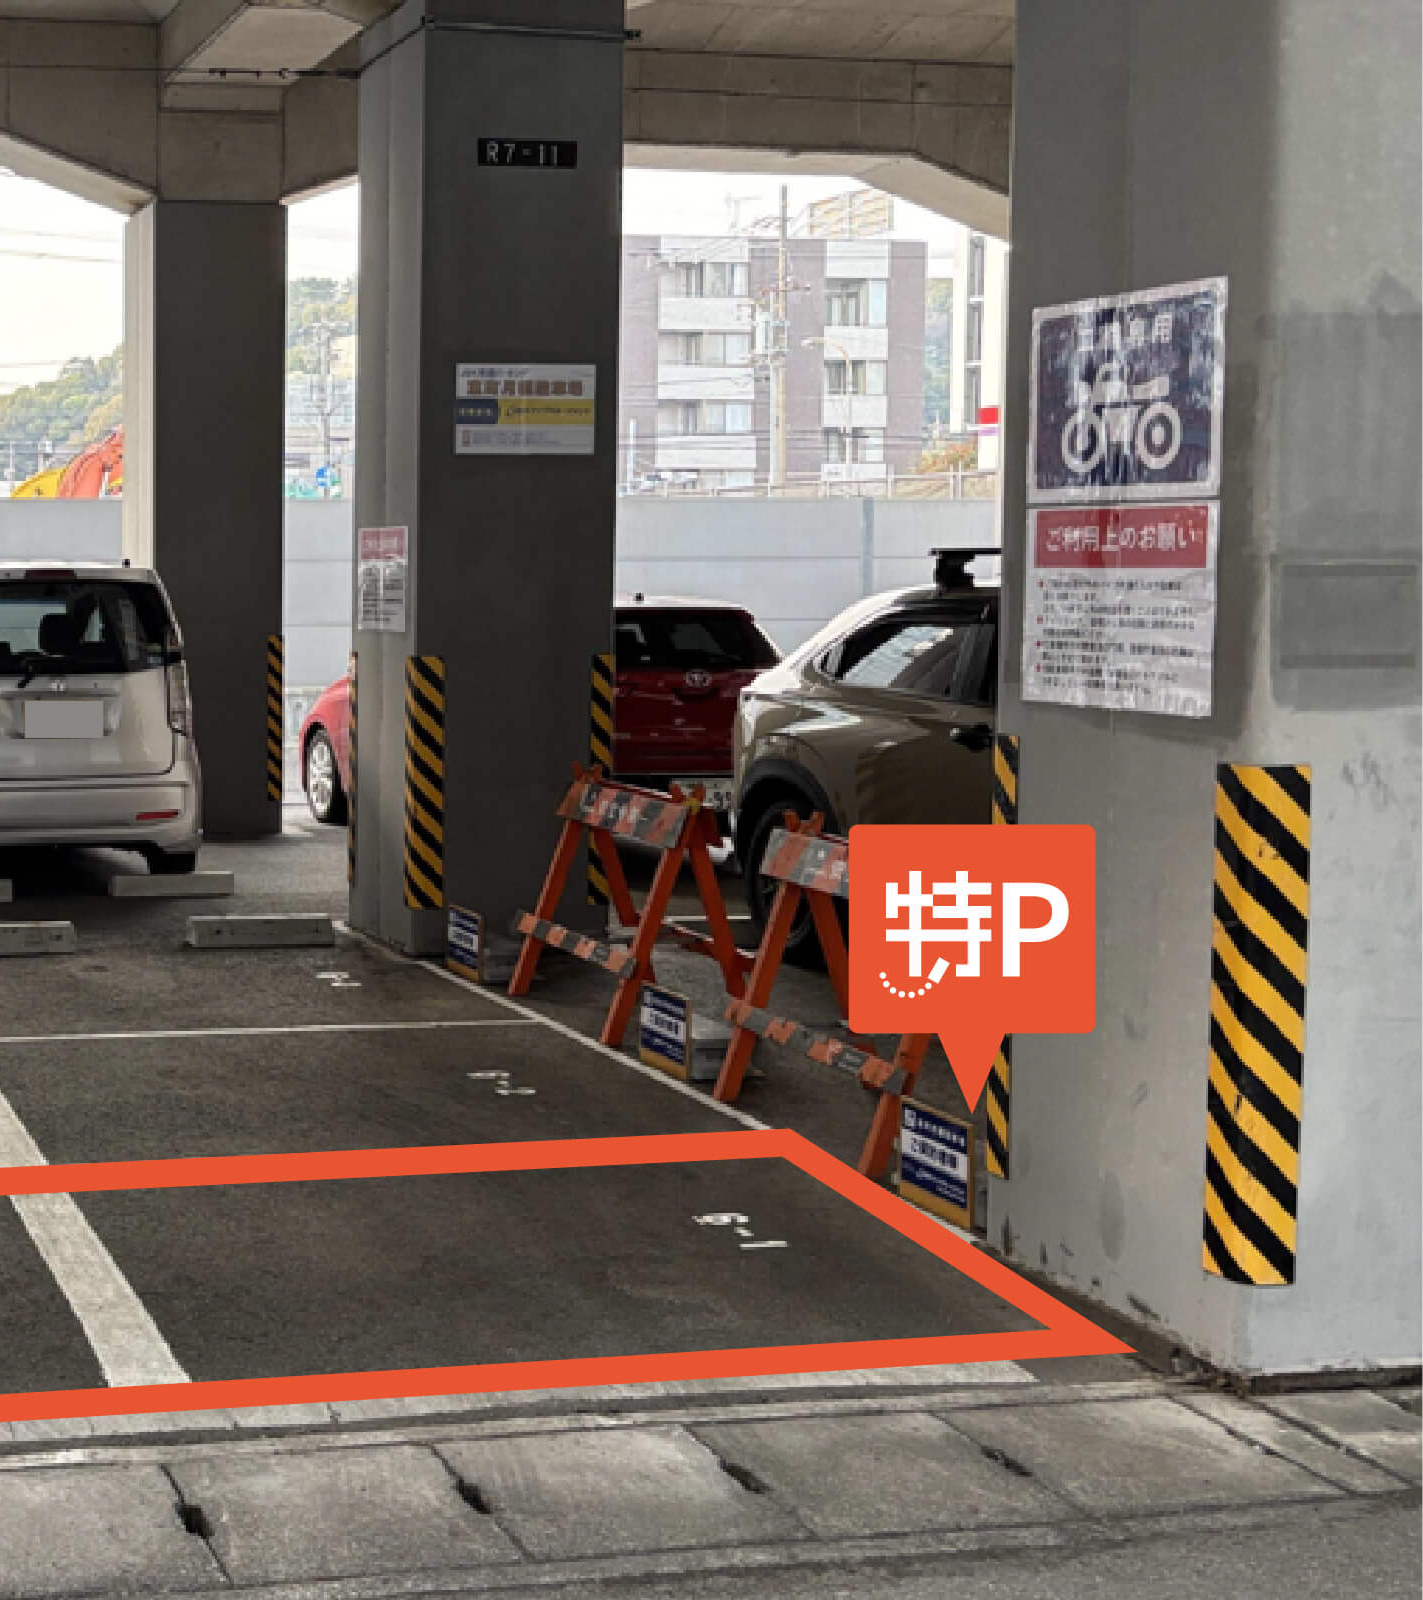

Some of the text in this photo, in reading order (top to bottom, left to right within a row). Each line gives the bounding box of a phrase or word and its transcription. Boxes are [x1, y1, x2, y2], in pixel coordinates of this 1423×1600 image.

[1046, 522, 1203, 554] ご利用上のお願い
